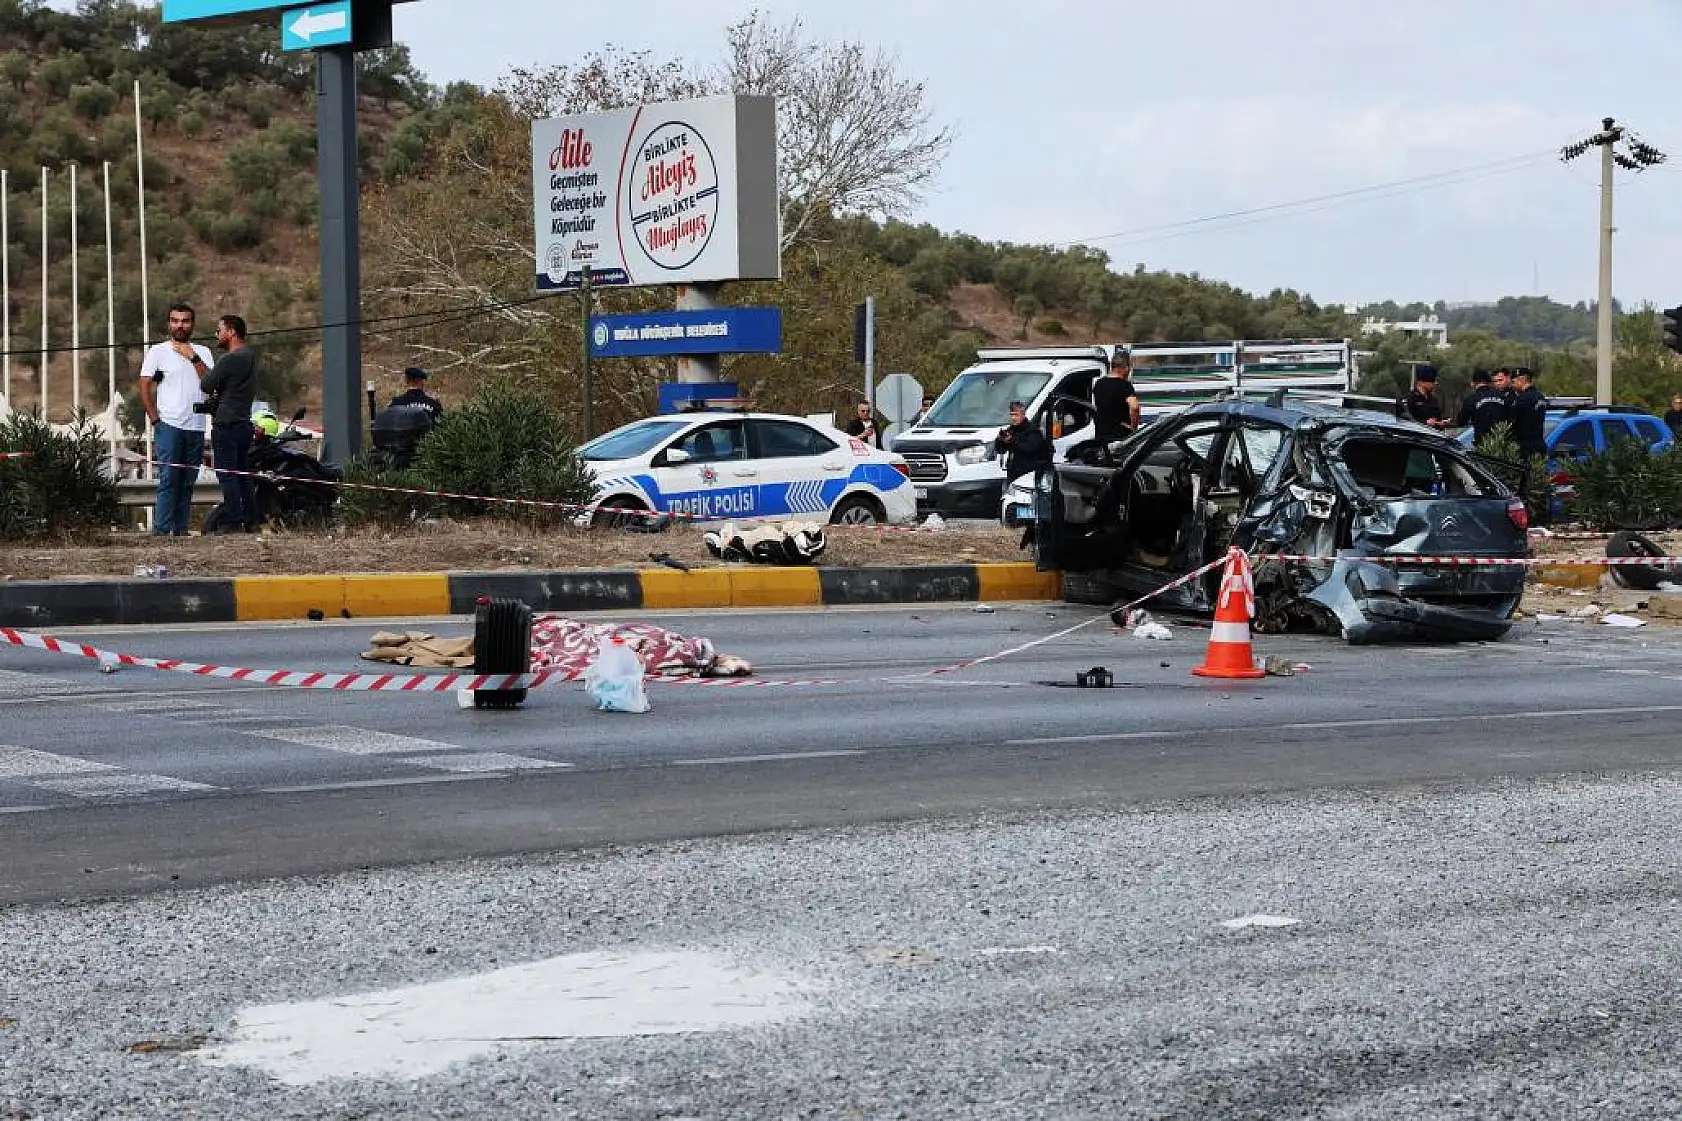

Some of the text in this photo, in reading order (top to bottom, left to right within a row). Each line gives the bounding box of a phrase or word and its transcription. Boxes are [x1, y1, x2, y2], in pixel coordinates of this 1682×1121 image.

[549, 128, 593, 171] Aile
[644, 133, 689, 162] BİRLİKTE
[641, 149, 697, 201] Aileyiz
[592, 191, 607, 209] bir
[652, 195, 697, 222] BİRLİKTE
[551, 216, 596, 237] Köprüdür
[667, 488, 754, 515] TRAFİK POLİSİ
